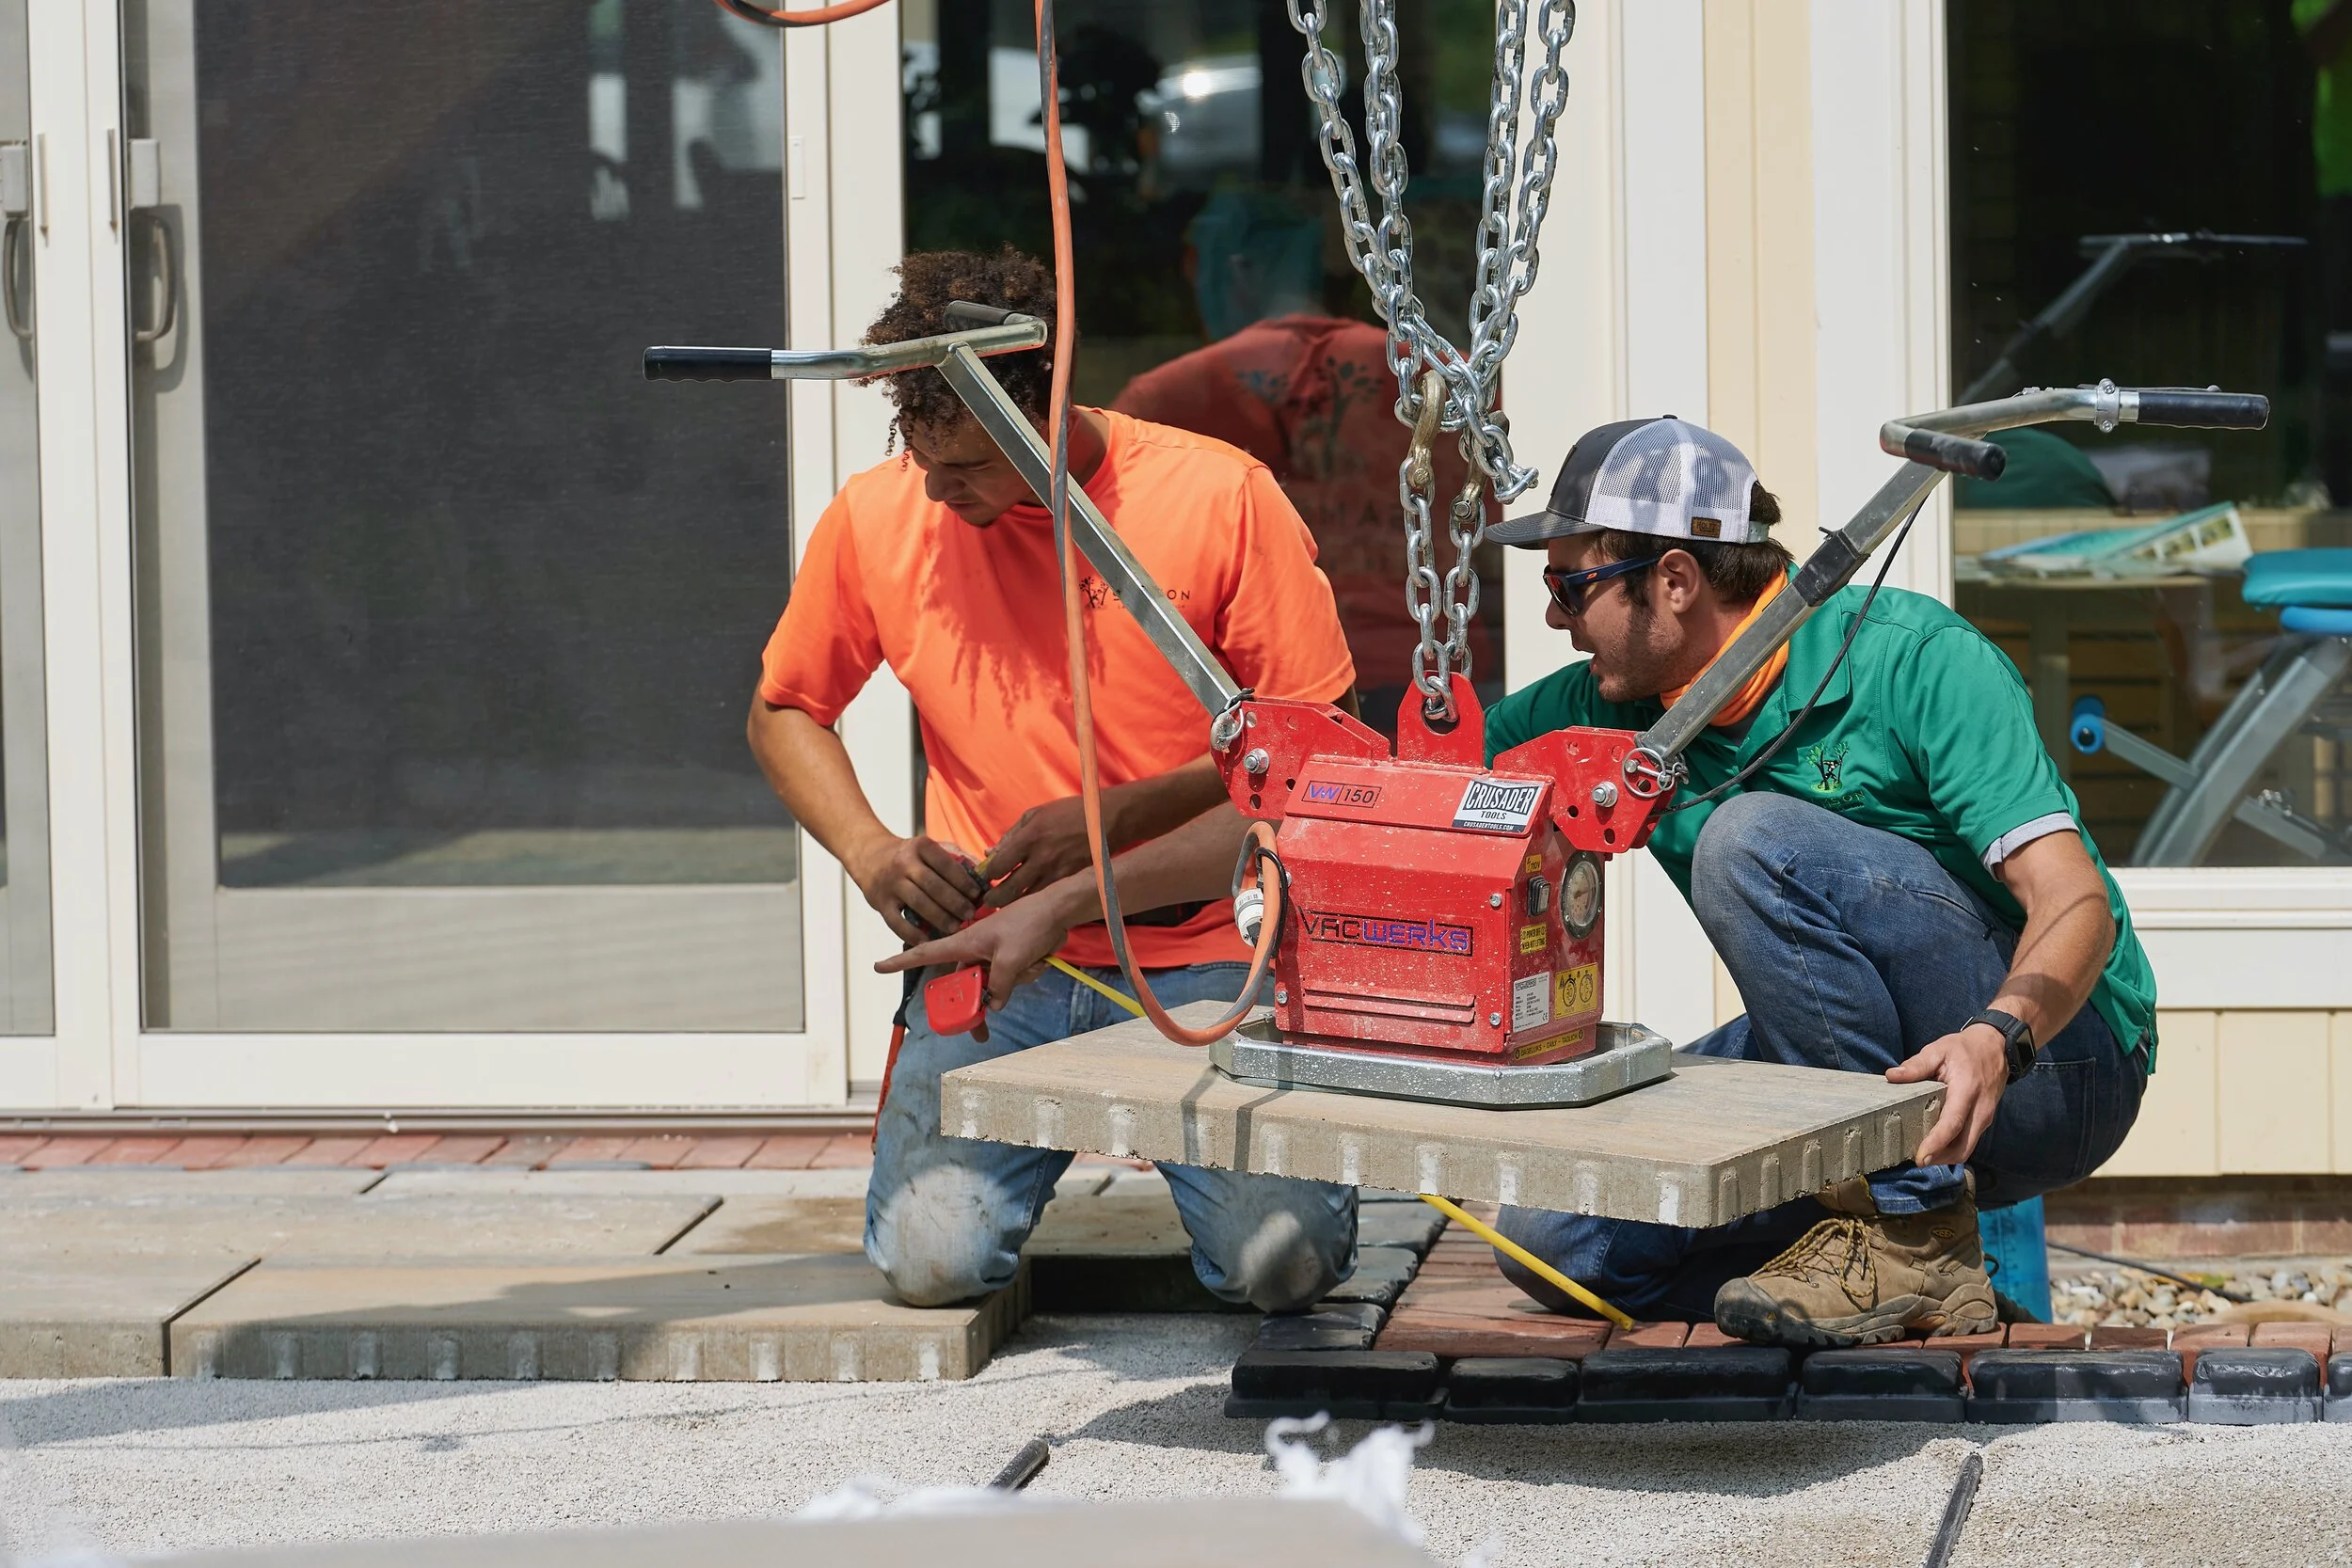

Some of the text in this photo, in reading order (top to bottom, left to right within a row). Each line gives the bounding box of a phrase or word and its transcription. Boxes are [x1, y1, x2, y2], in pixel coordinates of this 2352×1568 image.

[1344, 788, 1375, 803] 150
[1466, 783, 1535, 814] CRUSADER
[1480, 811, 1507, 820] TOOLS
[1463, 821, 1514, 831] CRUSADERTOOLS.COM
